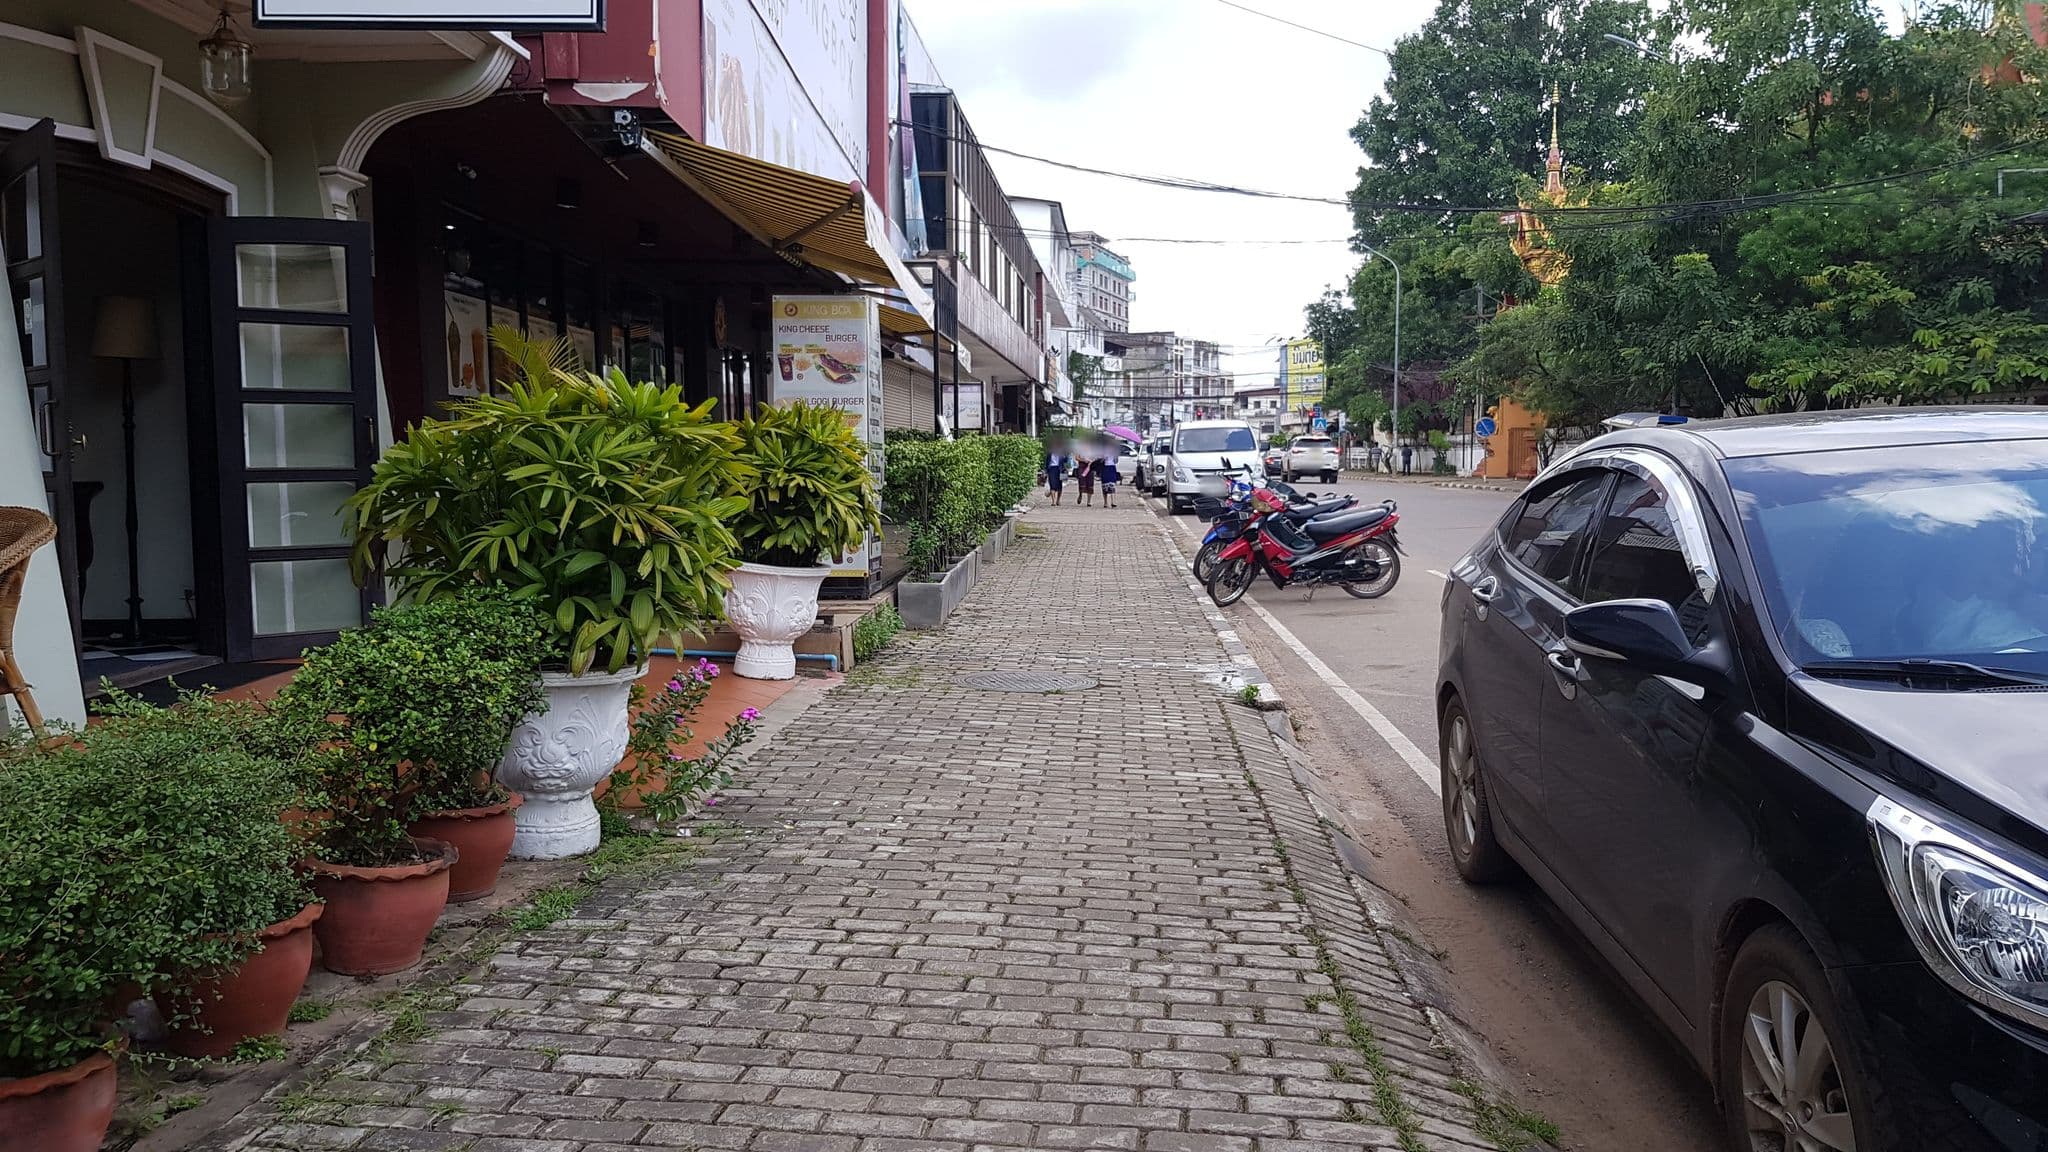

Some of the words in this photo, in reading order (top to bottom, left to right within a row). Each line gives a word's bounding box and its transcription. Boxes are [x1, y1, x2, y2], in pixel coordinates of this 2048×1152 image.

[778, 325, 798, 333] KING
[799, 325, 830, 333] CHEESE
[825, 334, 858, 342] BURGER
[796, 397, 829, 406] BLGOGI
[831, 397, 864, 406] BURGER
